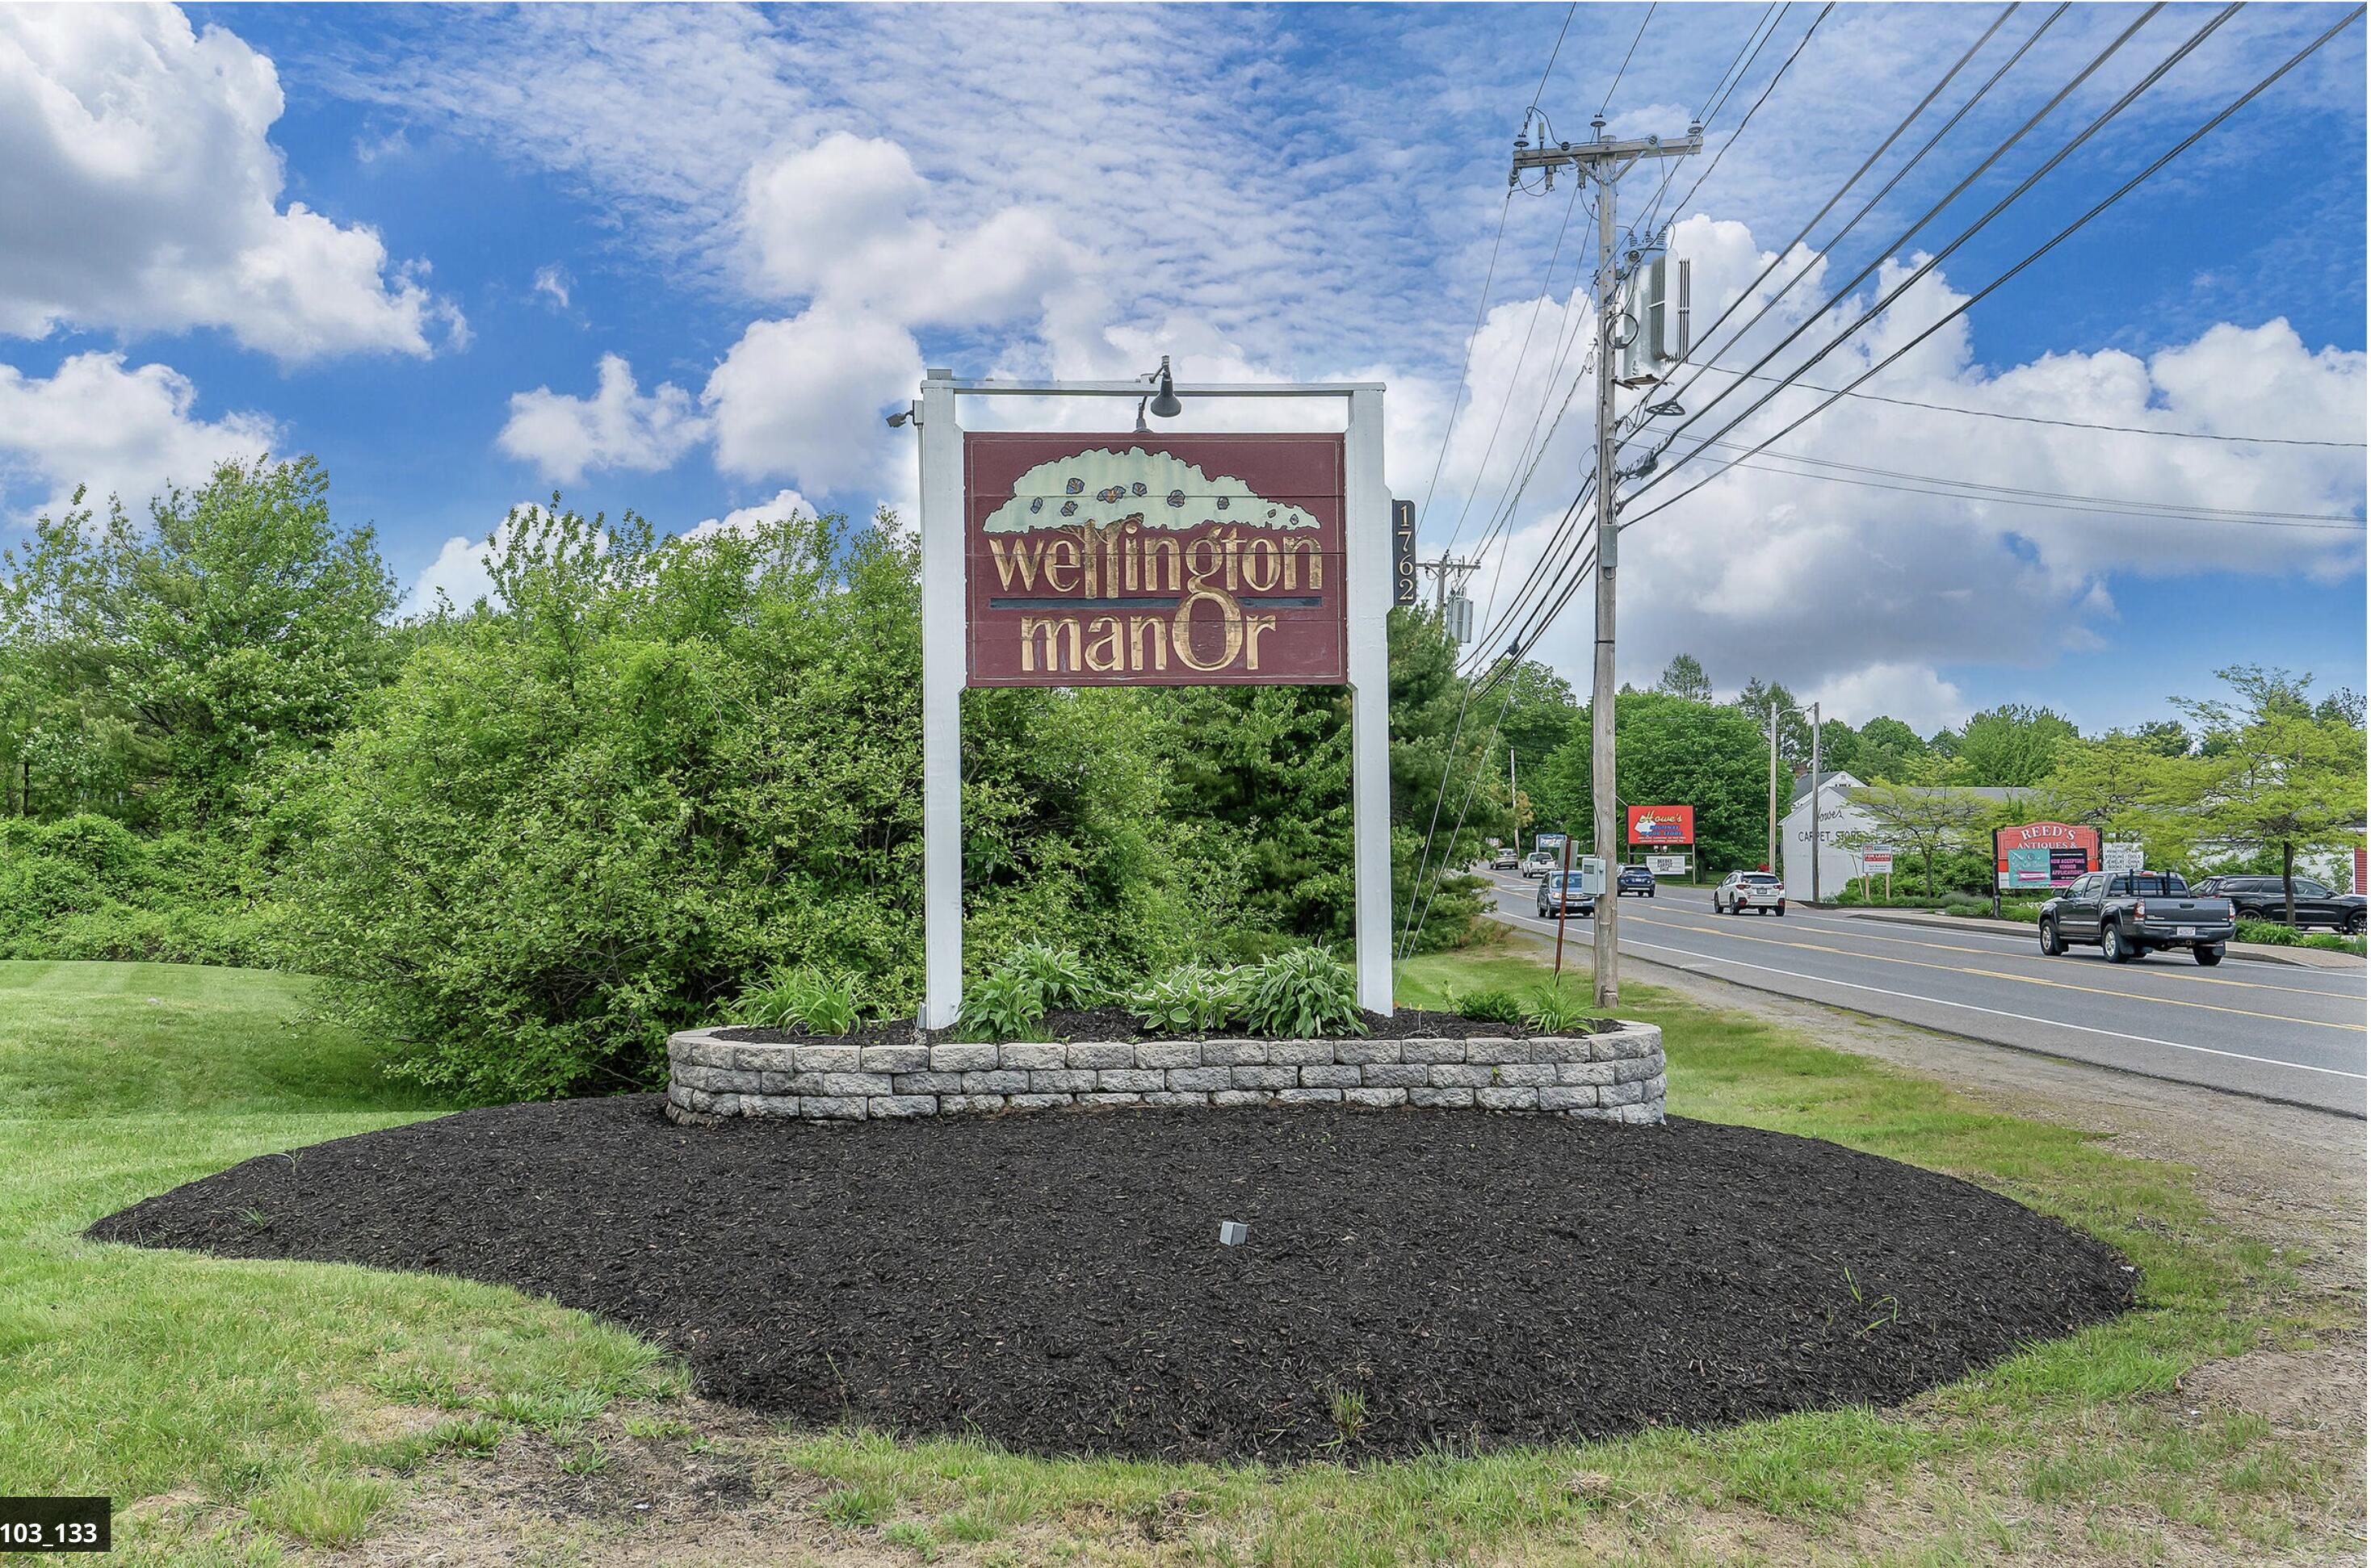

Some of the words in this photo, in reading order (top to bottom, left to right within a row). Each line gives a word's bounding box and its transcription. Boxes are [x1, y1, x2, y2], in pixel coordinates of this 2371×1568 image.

[988, 519, 1324, 599] wellington
[1397, 505, 1414, 601] 1762
[1639, 810, 1683, 823] Howe's
[1818, 807, 1844, 822] owes
[2021, 826, 2076, 841] REED'S
